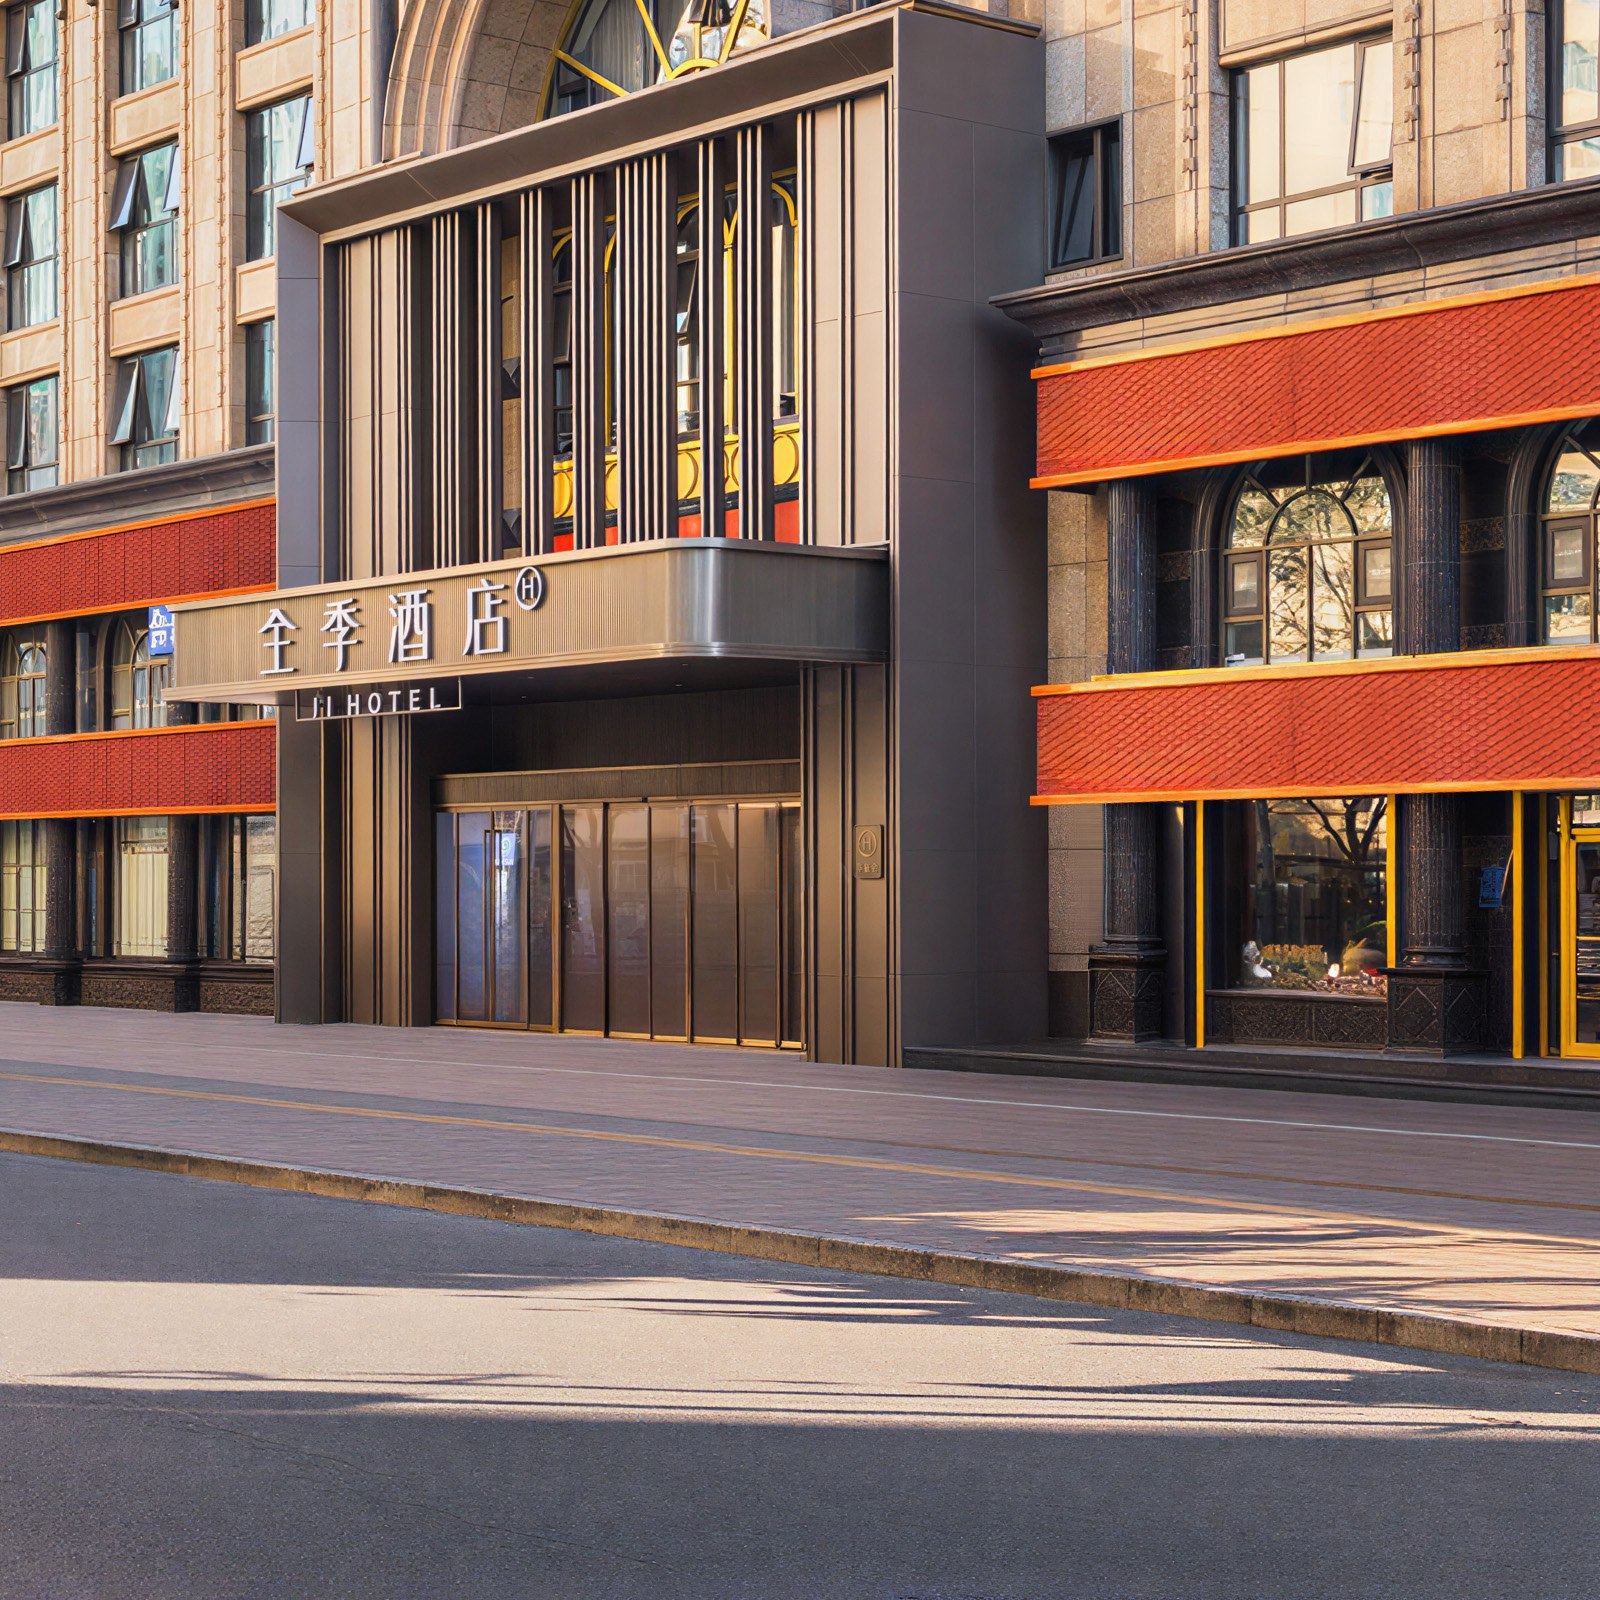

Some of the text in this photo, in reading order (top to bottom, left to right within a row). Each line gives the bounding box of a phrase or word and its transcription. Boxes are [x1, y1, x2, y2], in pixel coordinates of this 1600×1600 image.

[258, 578, 506, 675] 全季酒店
[313, 687, 441, 719] JI HOTEL
